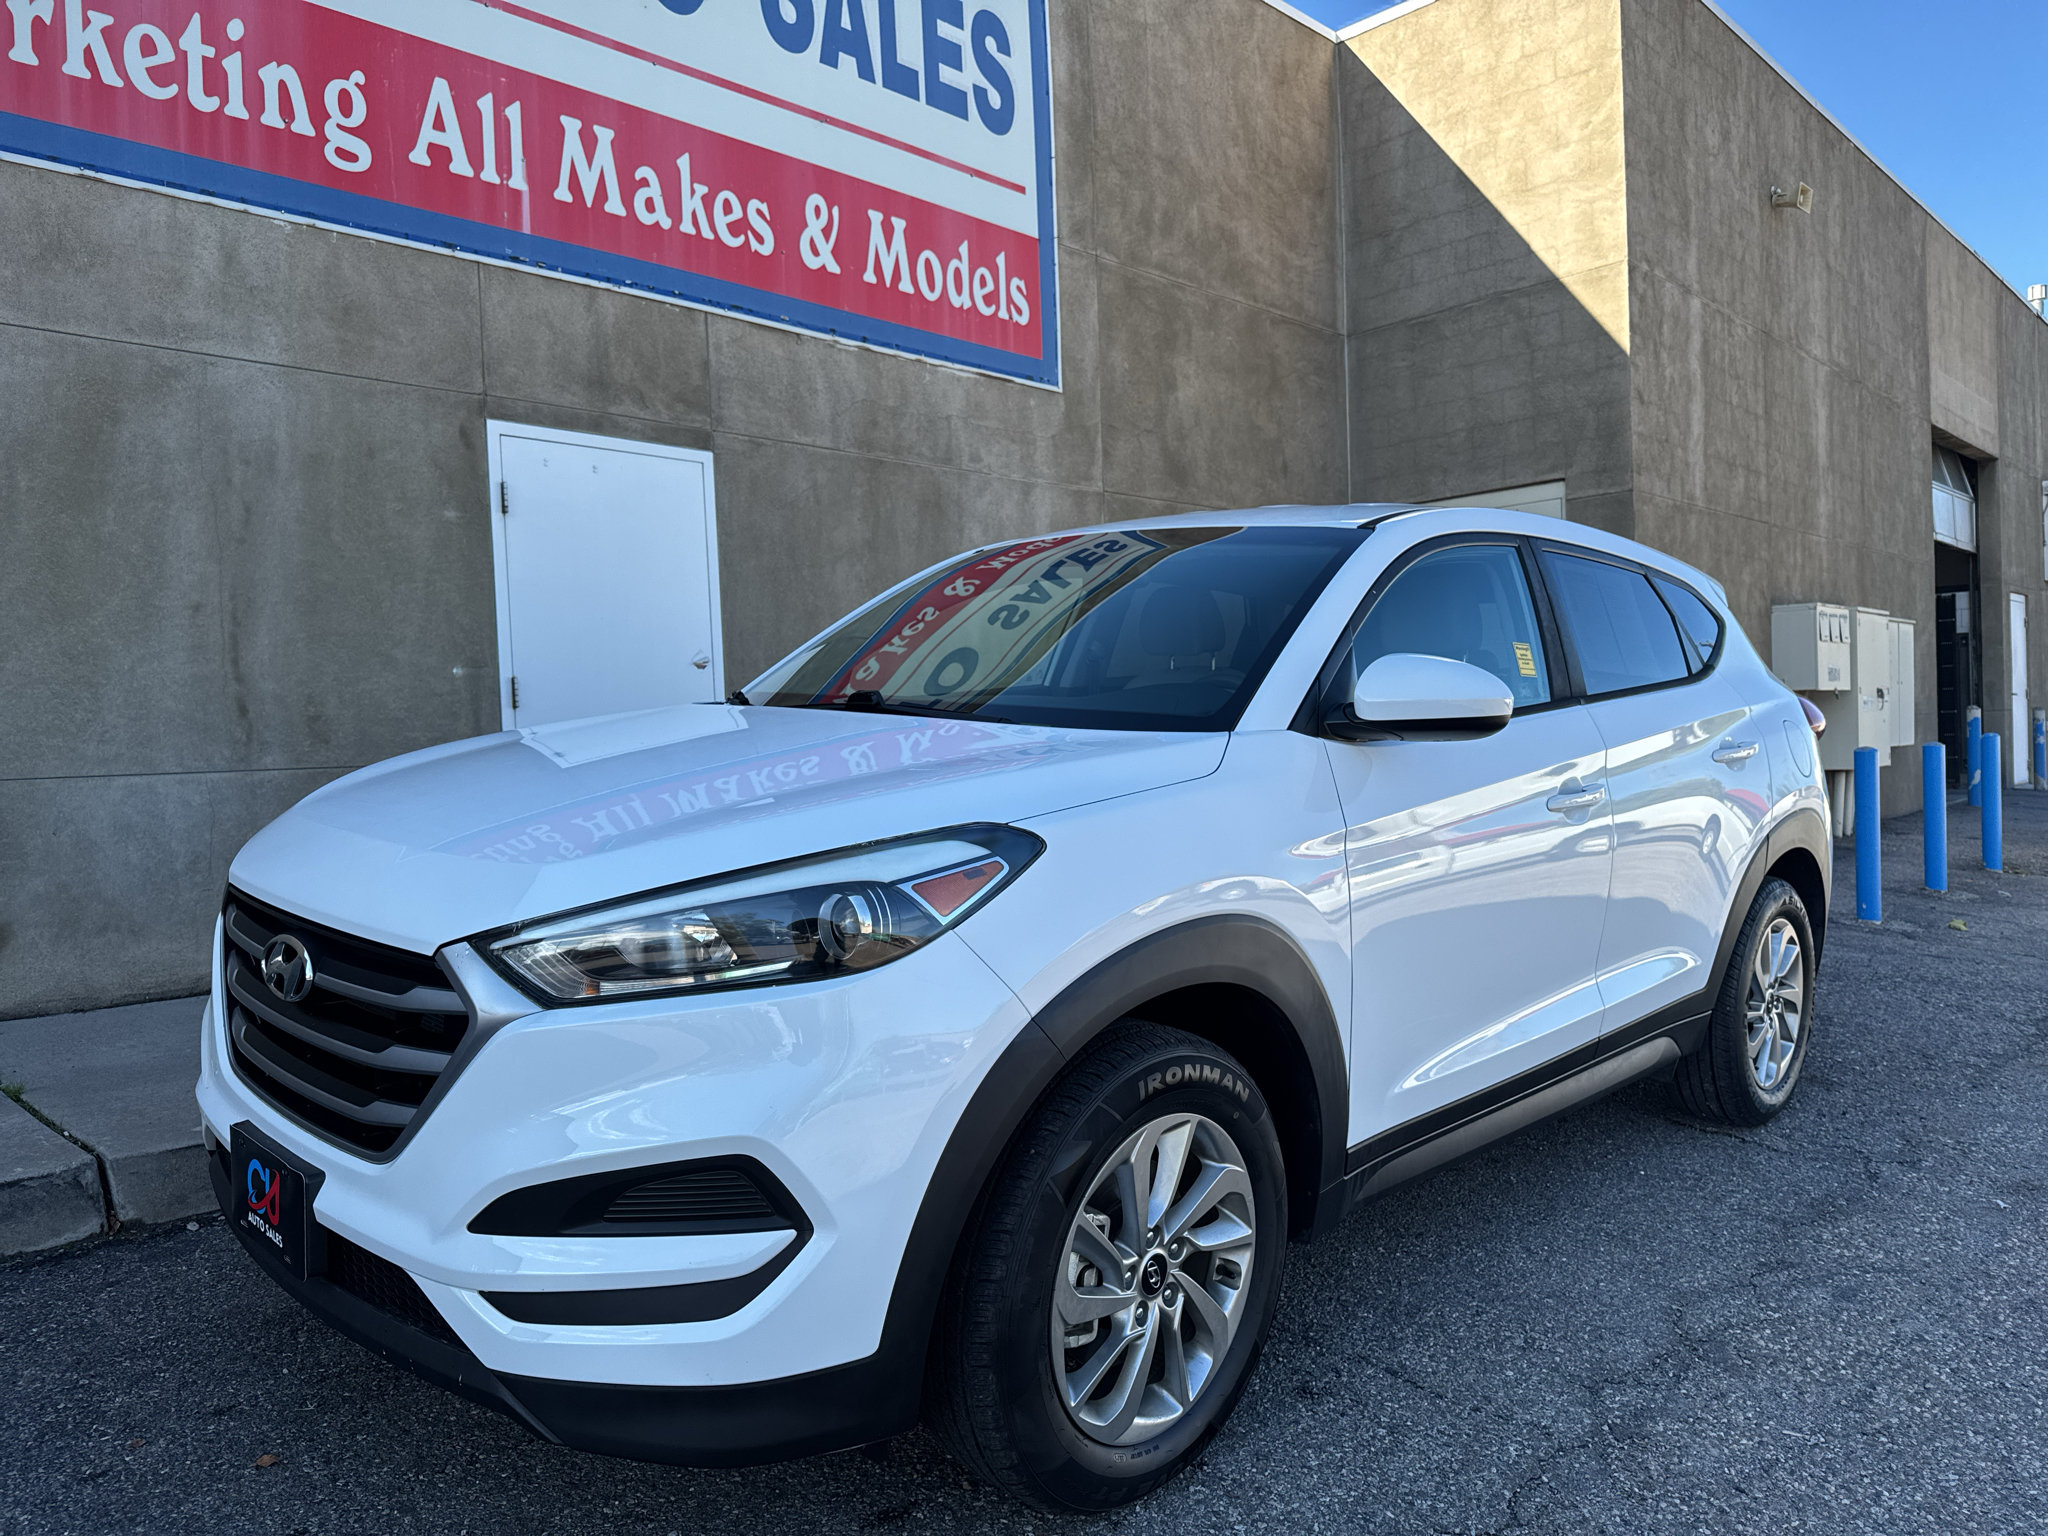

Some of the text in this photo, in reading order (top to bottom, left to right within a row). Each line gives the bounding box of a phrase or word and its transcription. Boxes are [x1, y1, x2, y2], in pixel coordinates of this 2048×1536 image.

[5, 0, 1031, 326] rketing All Makes & Models
[1138, 1064, 1250, 1103] IRONMAN
[248, 1210, 283, 1248] AUTO SALES
